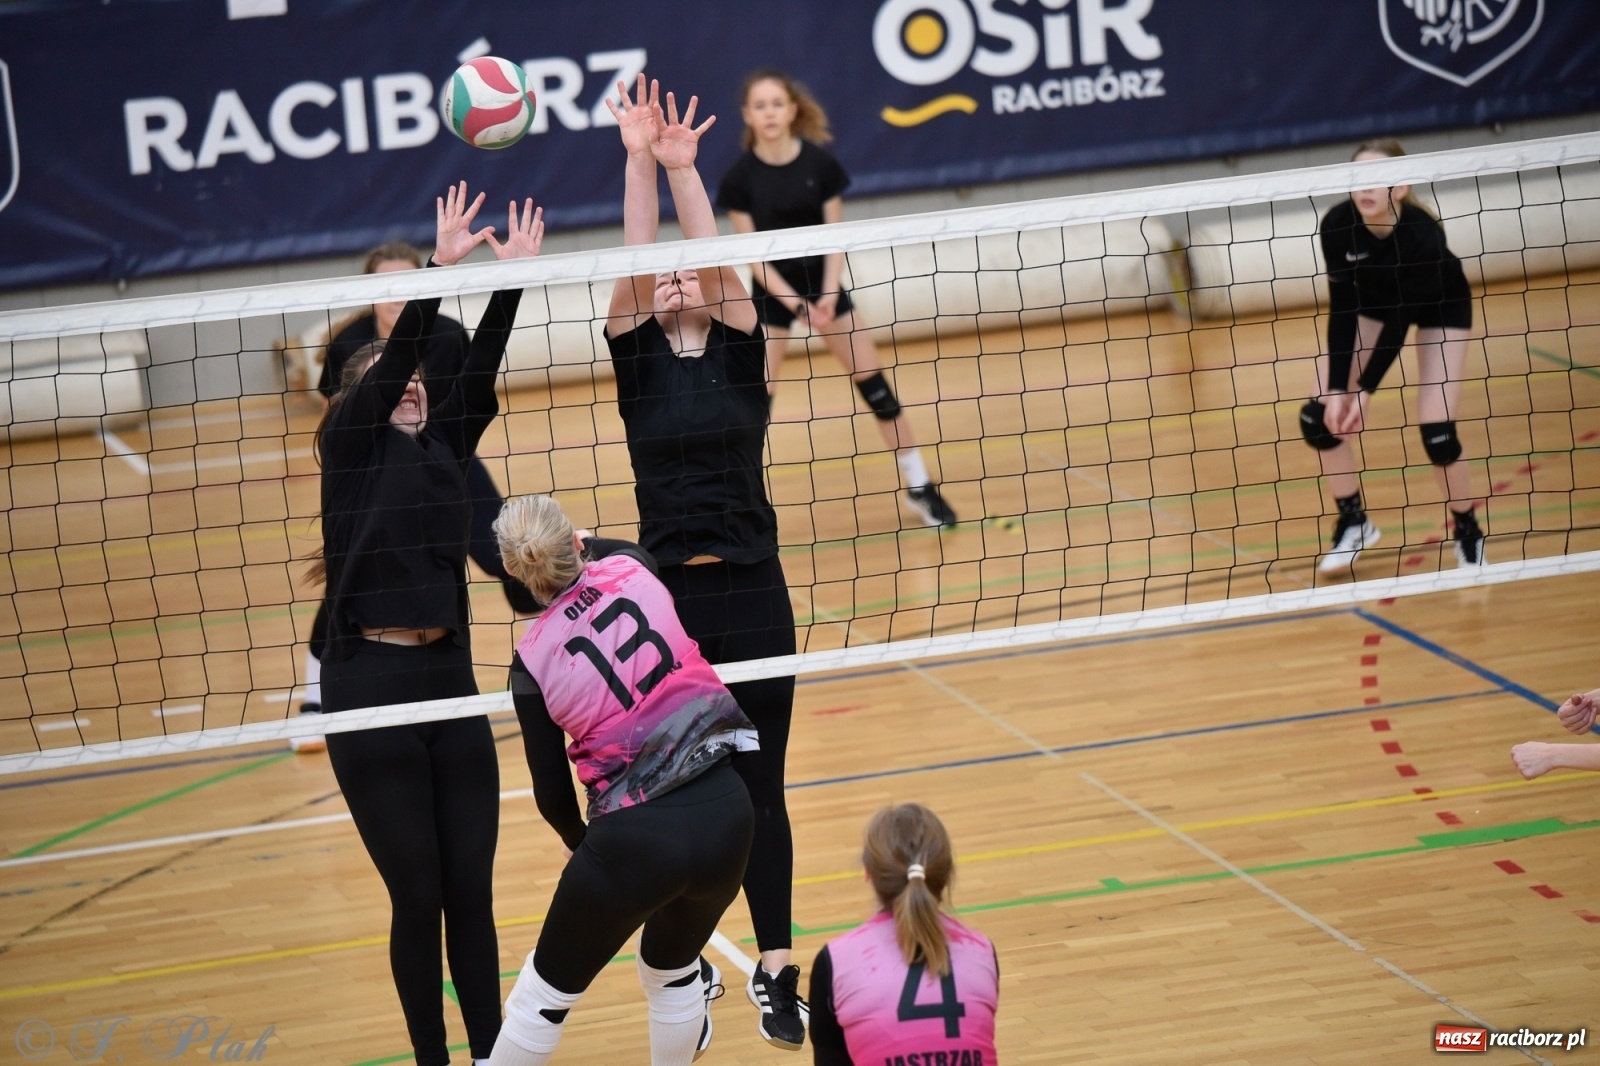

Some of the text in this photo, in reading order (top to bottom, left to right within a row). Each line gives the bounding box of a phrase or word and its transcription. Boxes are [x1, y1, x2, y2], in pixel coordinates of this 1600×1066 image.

[124, 38, 647, 175] RACIBRZ
[991, 67, 1165, 114] RACIBÓRZ
[563, 586, 603, 621] OLGA
[564, 597, 675, 712] 13
[897, 942, 966, 1038] 4
